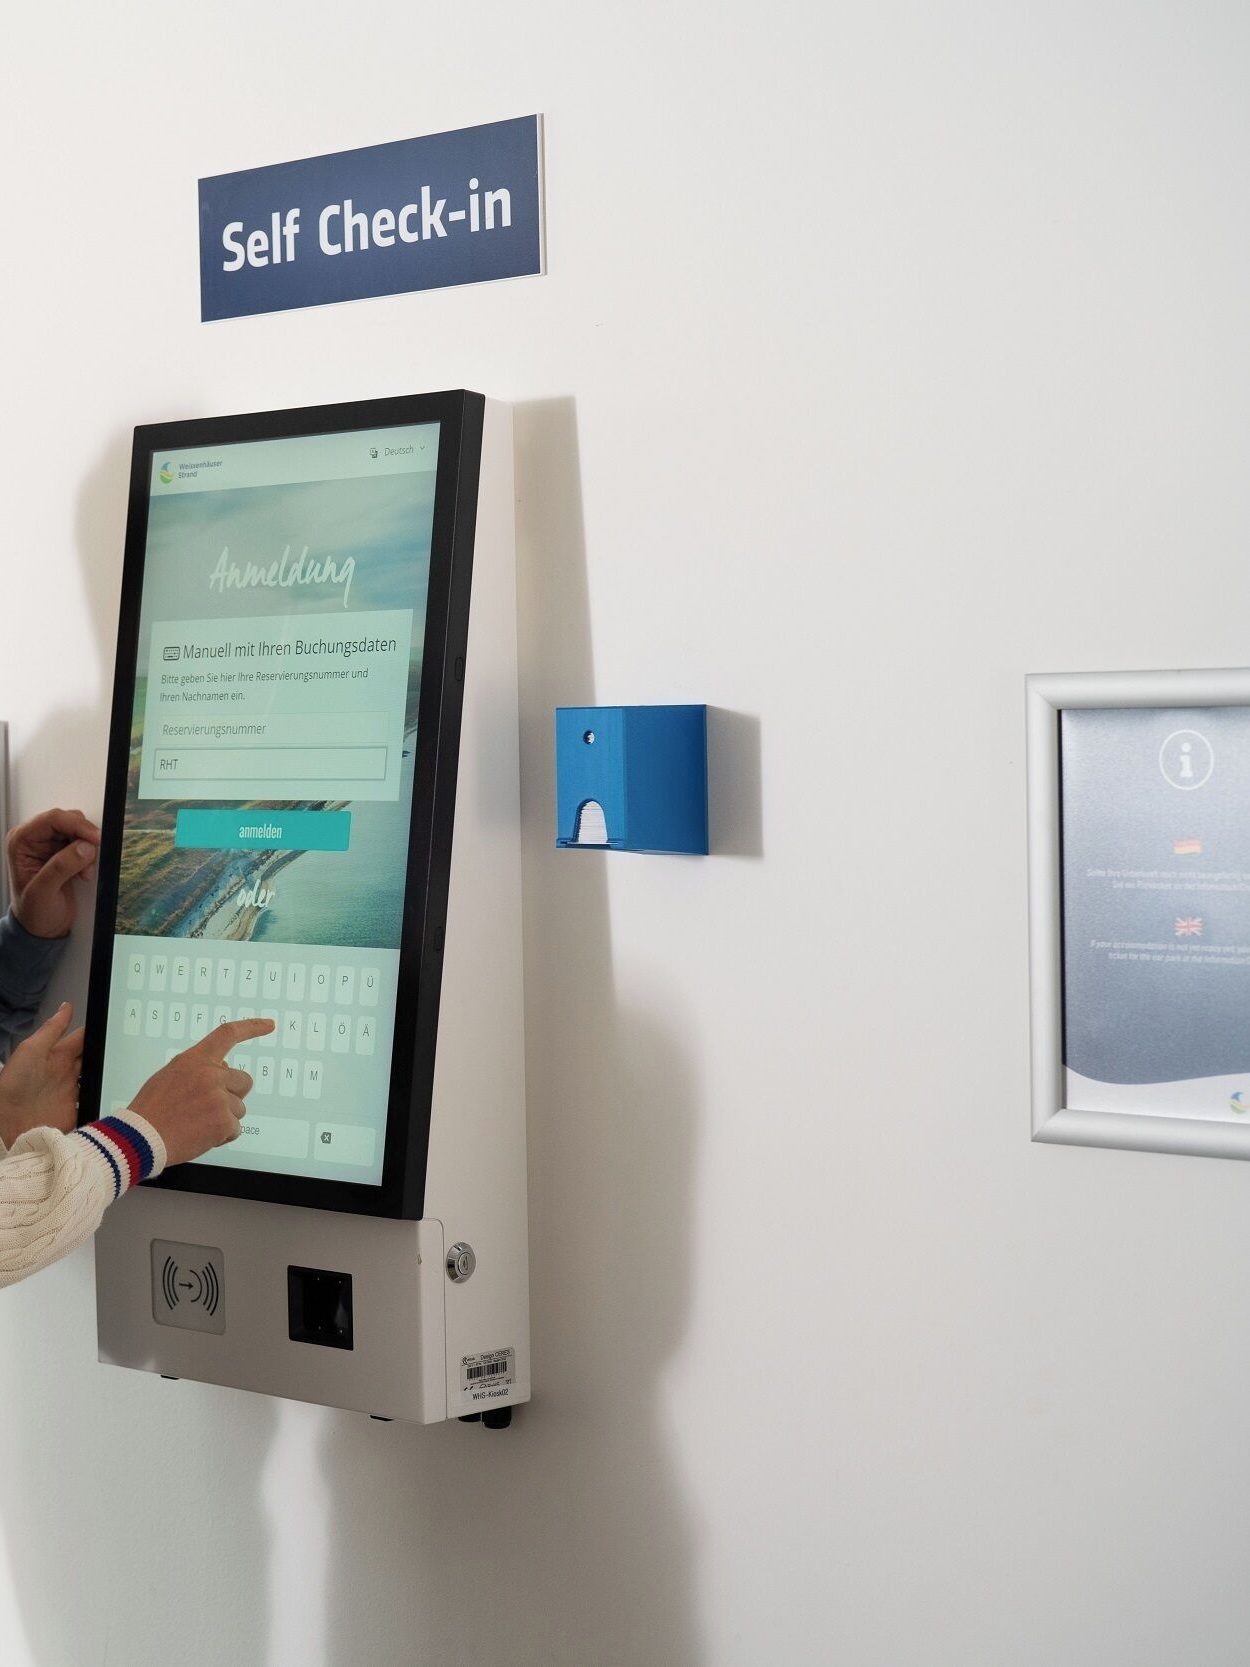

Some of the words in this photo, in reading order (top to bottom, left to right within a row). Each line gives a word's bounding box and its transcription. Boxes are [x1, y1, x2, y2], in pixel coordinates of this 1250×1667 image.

[222, 207, 301, 272] Self
[319, 177, 512, 256] Check-in
[384, 445, 414, 456] Deutsch
[178, 470, 198, 479] Strand
[208, 544, 356, 609] Anmeldung
[183, 642, 232, 659] Manuell
[234, 641, 255, 657] mit
[258, 640, 291, 656] Ihren
[295, 637, 397, 657] Buchungsdaten
[161, 674, 179, 685] Bitte
[180, 674, 205, 686] geben
[206, 672, 219, 683] Sie
[220, 672, 236, 682] hier
[238, 671, 254, 682] Ihre
[255, 670, 349, 682] Reservierungsnummer
[351, 668, 369, 678] und
[160, 692, 180, 702] Ihren
[182, 691, 229, 702] Nachnamen
[231, 690, 246, 701] ein.
[162, 723, 267, 738] Reservierungsnummer
[159, 758, 179, 770] RHT
[238, 824, 283, 840] anmelden
[236, 878, 276, 908] oder
[134, 963, 141, 973] Q
[155, 964, 165, 975] W
[177, 965, 184, 976] E
[200, 967, 207, 977] R
[223, 968, 229, 979] T
[245, 969, 252, 980] Z
[269, 971, 277, 982] U
[317, 974, 325, 985] O
[341, 975, 349, 986] P
[130, 1008, 136, 1018] A
[151, 1009, 158, 1020] S
[174, 1011, 181, 1022] D
[196, 1013, 203, 1023] F
[289, 1020, 296, 1031] K
[313, 1022, 319, 1033] L
[338, 1022, 346, 1035] Ö
[362, 1023, 370, 1037] Ä
[262, 1065, 269, 1077] B
[285, 1068, 293, 1079] N
[309, 1070, 318, 1081] M
[239, 1125, 261, 1136] pace
